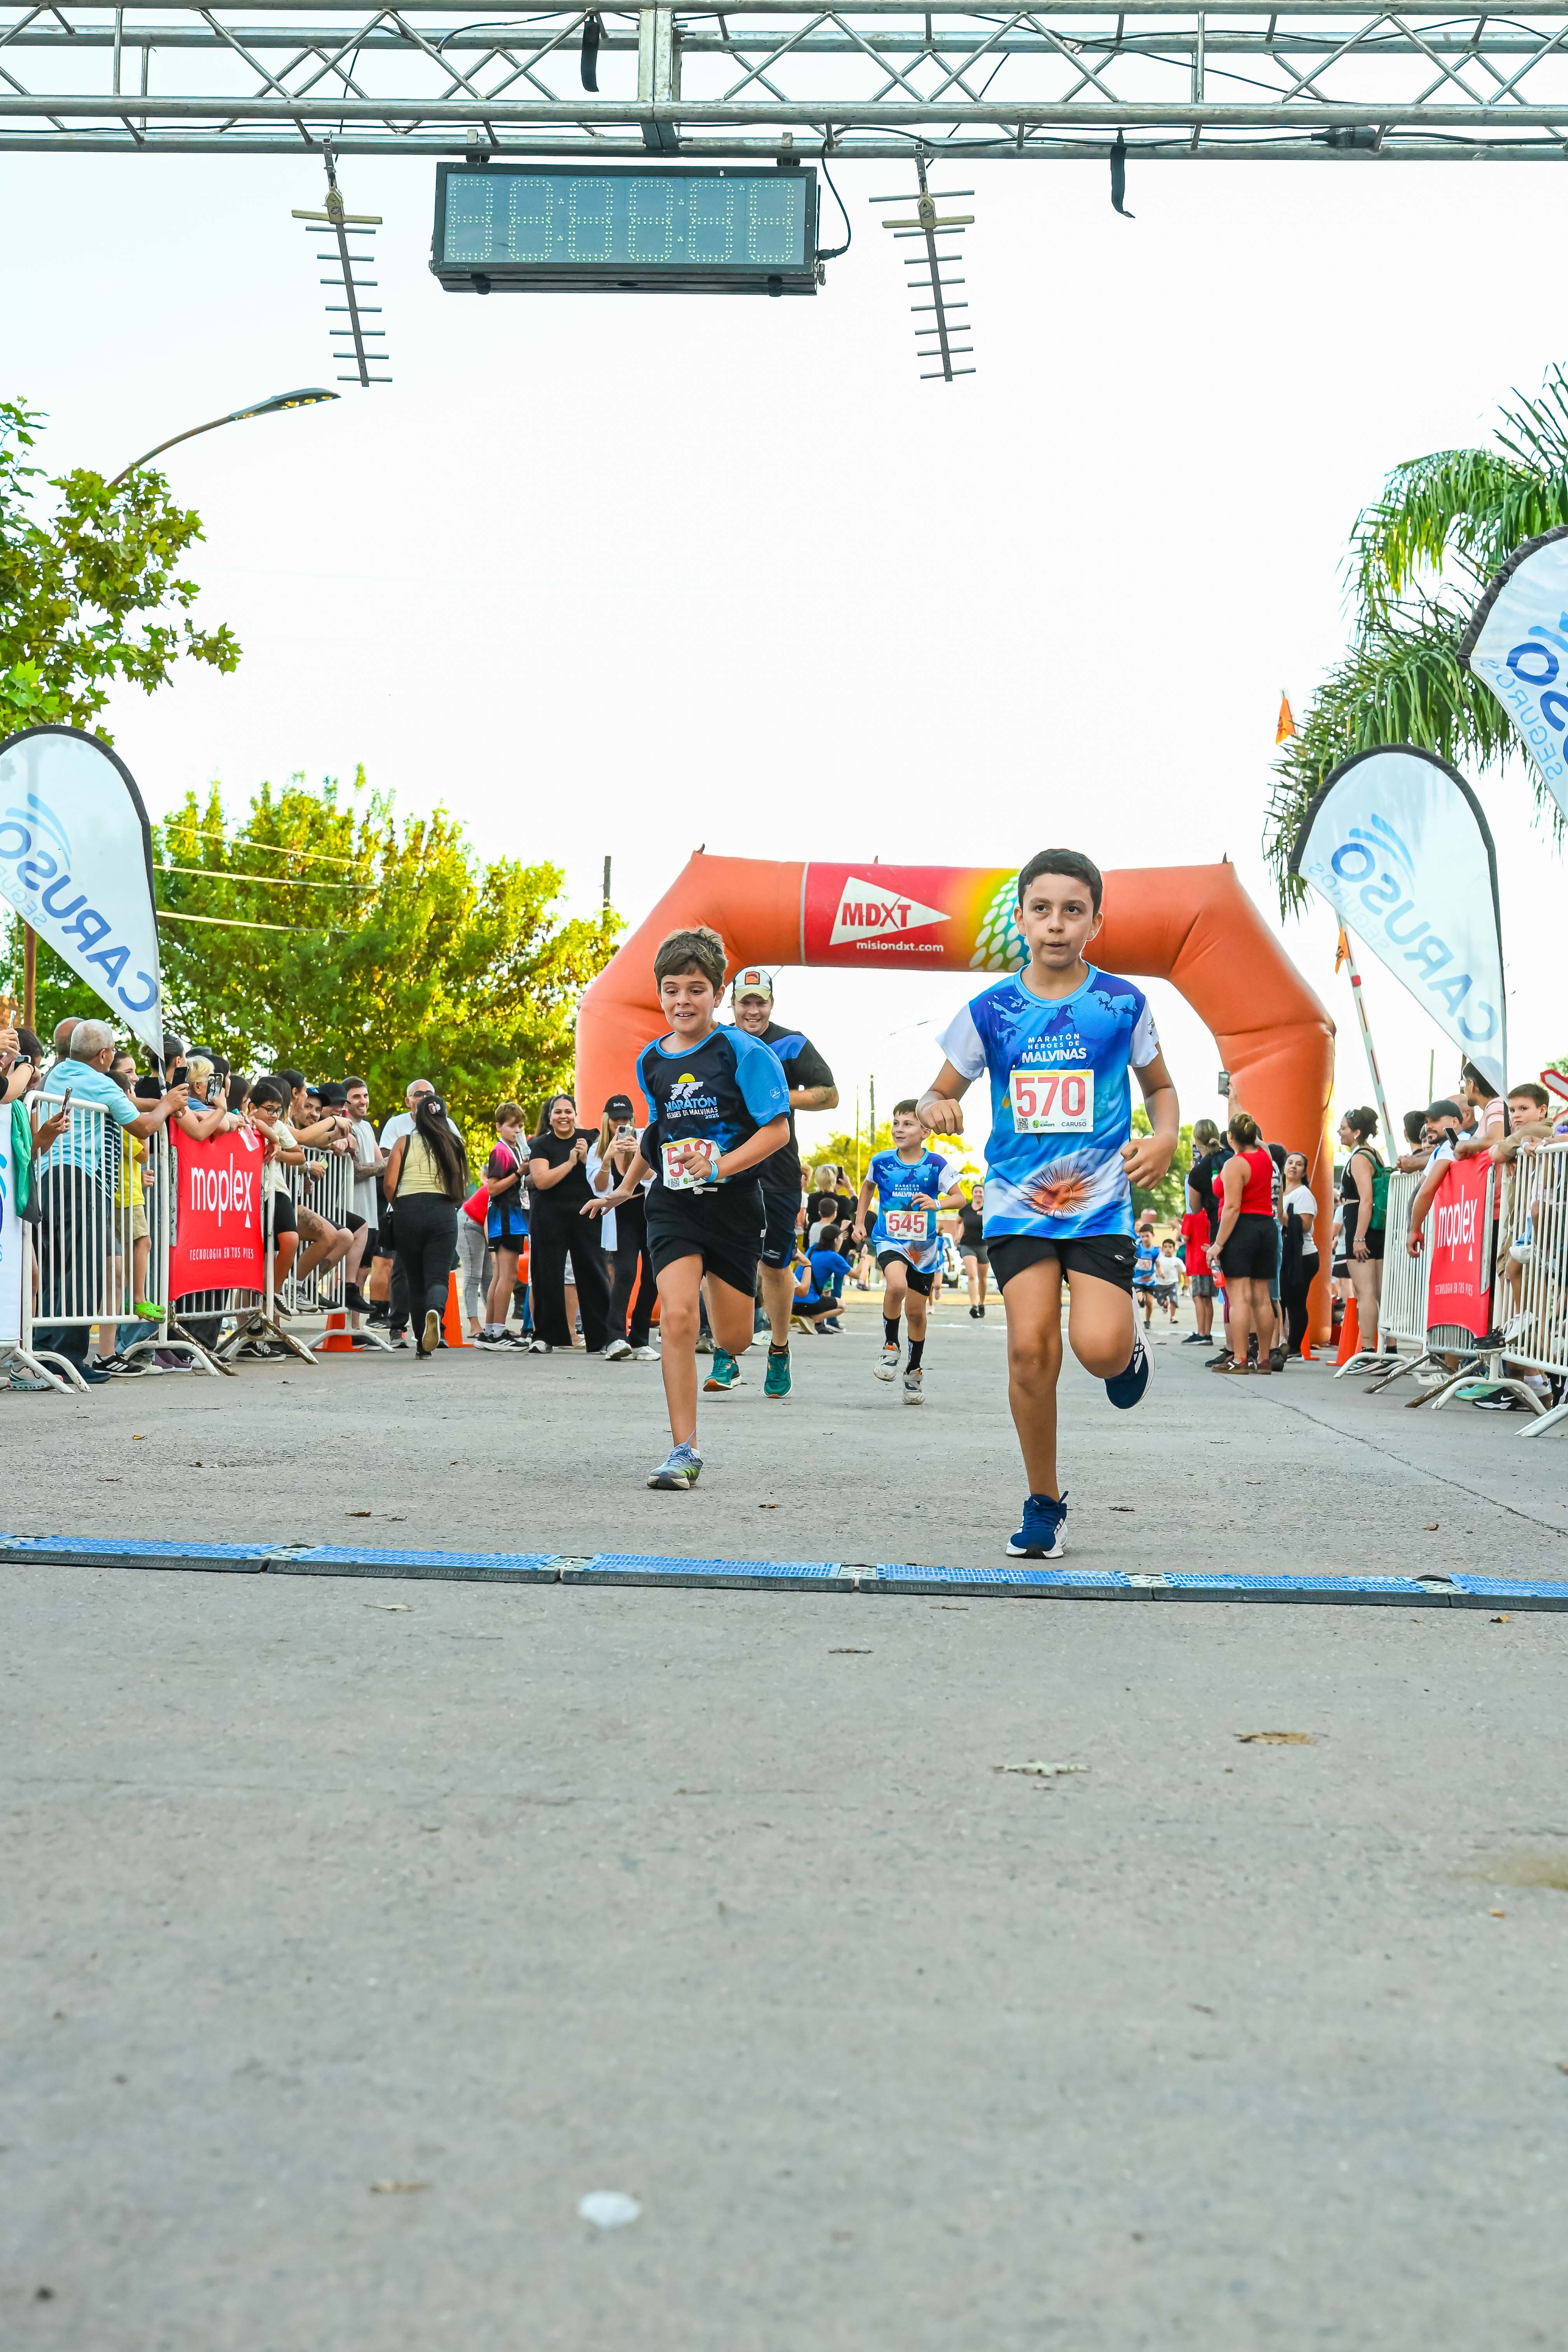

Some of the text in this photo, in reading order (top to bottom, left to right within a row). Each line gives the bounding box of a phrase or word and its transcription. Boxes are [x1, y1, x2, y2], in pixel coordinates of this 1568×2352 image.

[842, 896, 911, 930] MDXT
[856, 940, 944, 952] misiondxt.com
[1028, 1033, 1080, 1043] MARATÓN
[1022, 1047, 1087, 1063] MALVINAS
[664, 1094, 717, 1112] MARATÓN
[1015, 1076, 1085, 1117] 570
[689, 1107, 718, 1115] MALVINAS
[191, 1153, 253, 1227] moplex
[889, 1213, 925, 1234] 545
[1437, 1184, 1477, 1262] moplex
[190, 1247, 254, 1260] TECNOLOGIA EN TUS PIES
